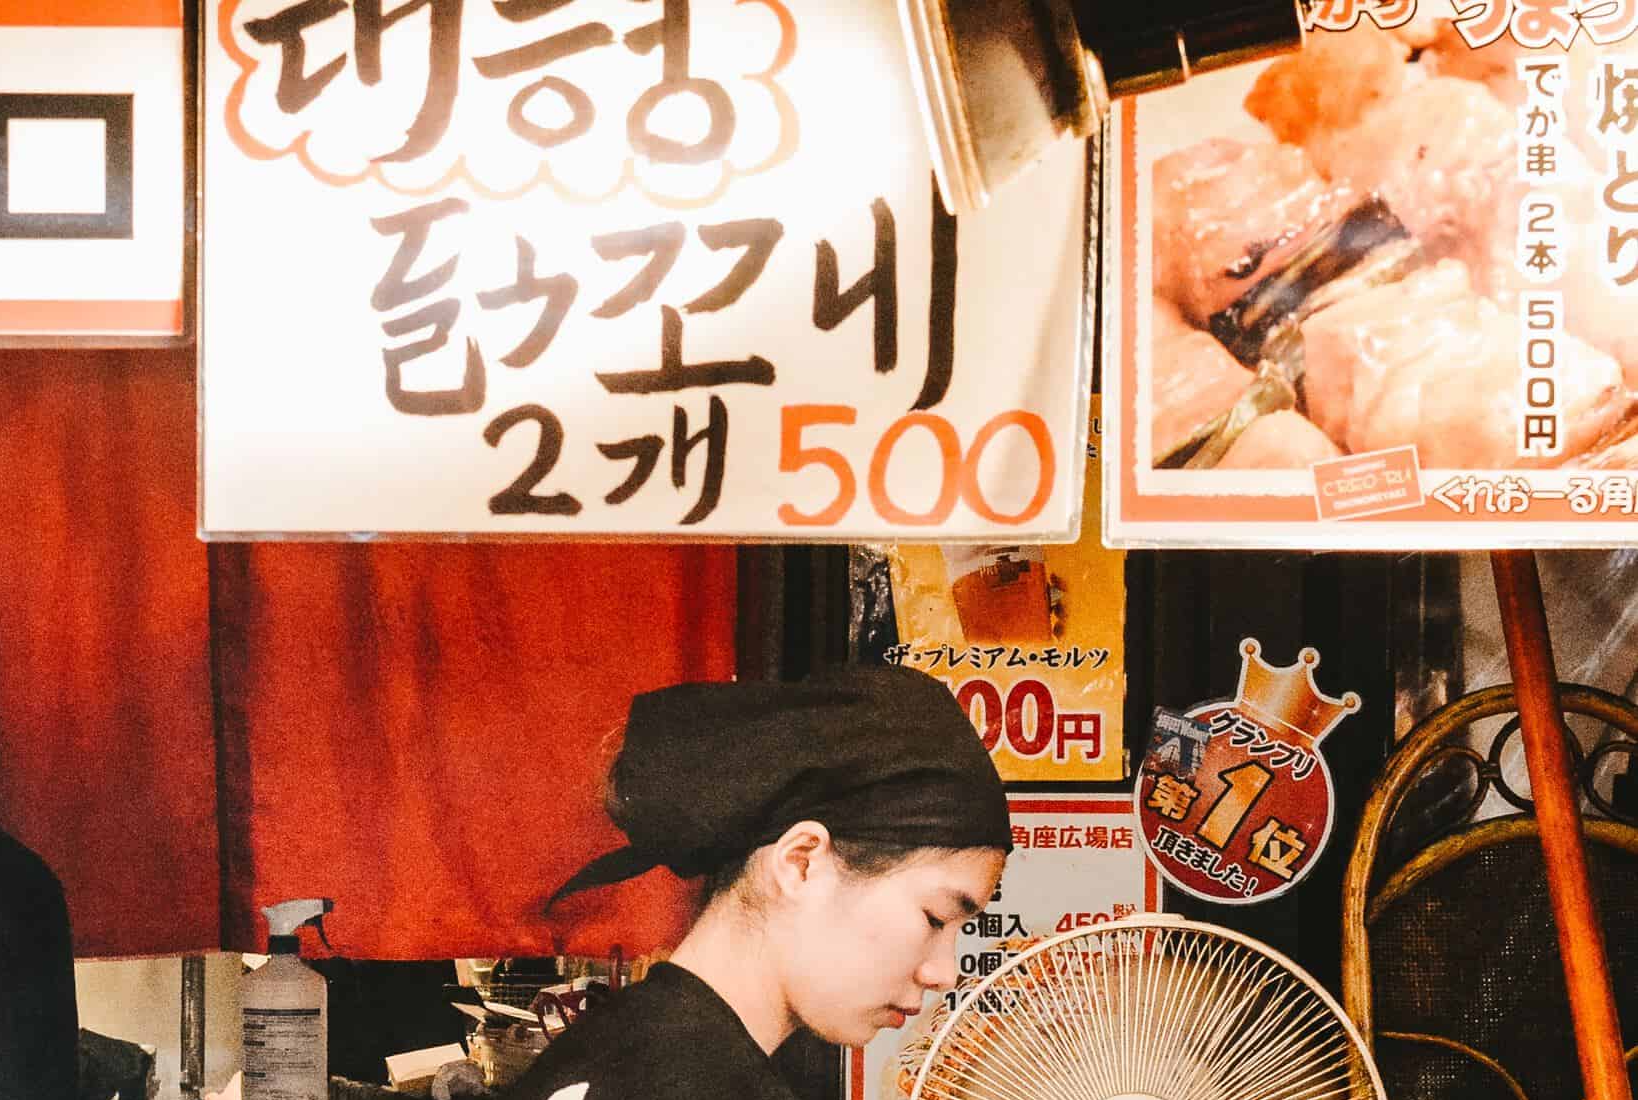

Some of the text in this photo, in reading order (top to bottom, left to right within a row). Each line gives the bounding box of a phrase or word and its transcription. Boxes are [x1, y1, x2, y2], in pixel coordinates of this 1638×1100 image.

[1524, 63, 1561, 177] でか串
[1525, 300, 1559, 450] 500円
[482, 394, 1058, 527] 2개 500
[1433, 475, 1638, 515] くれおーる角
[955, 679, 1101, 760] 00円
[1212, 713, 1315, 779] グランプリ
